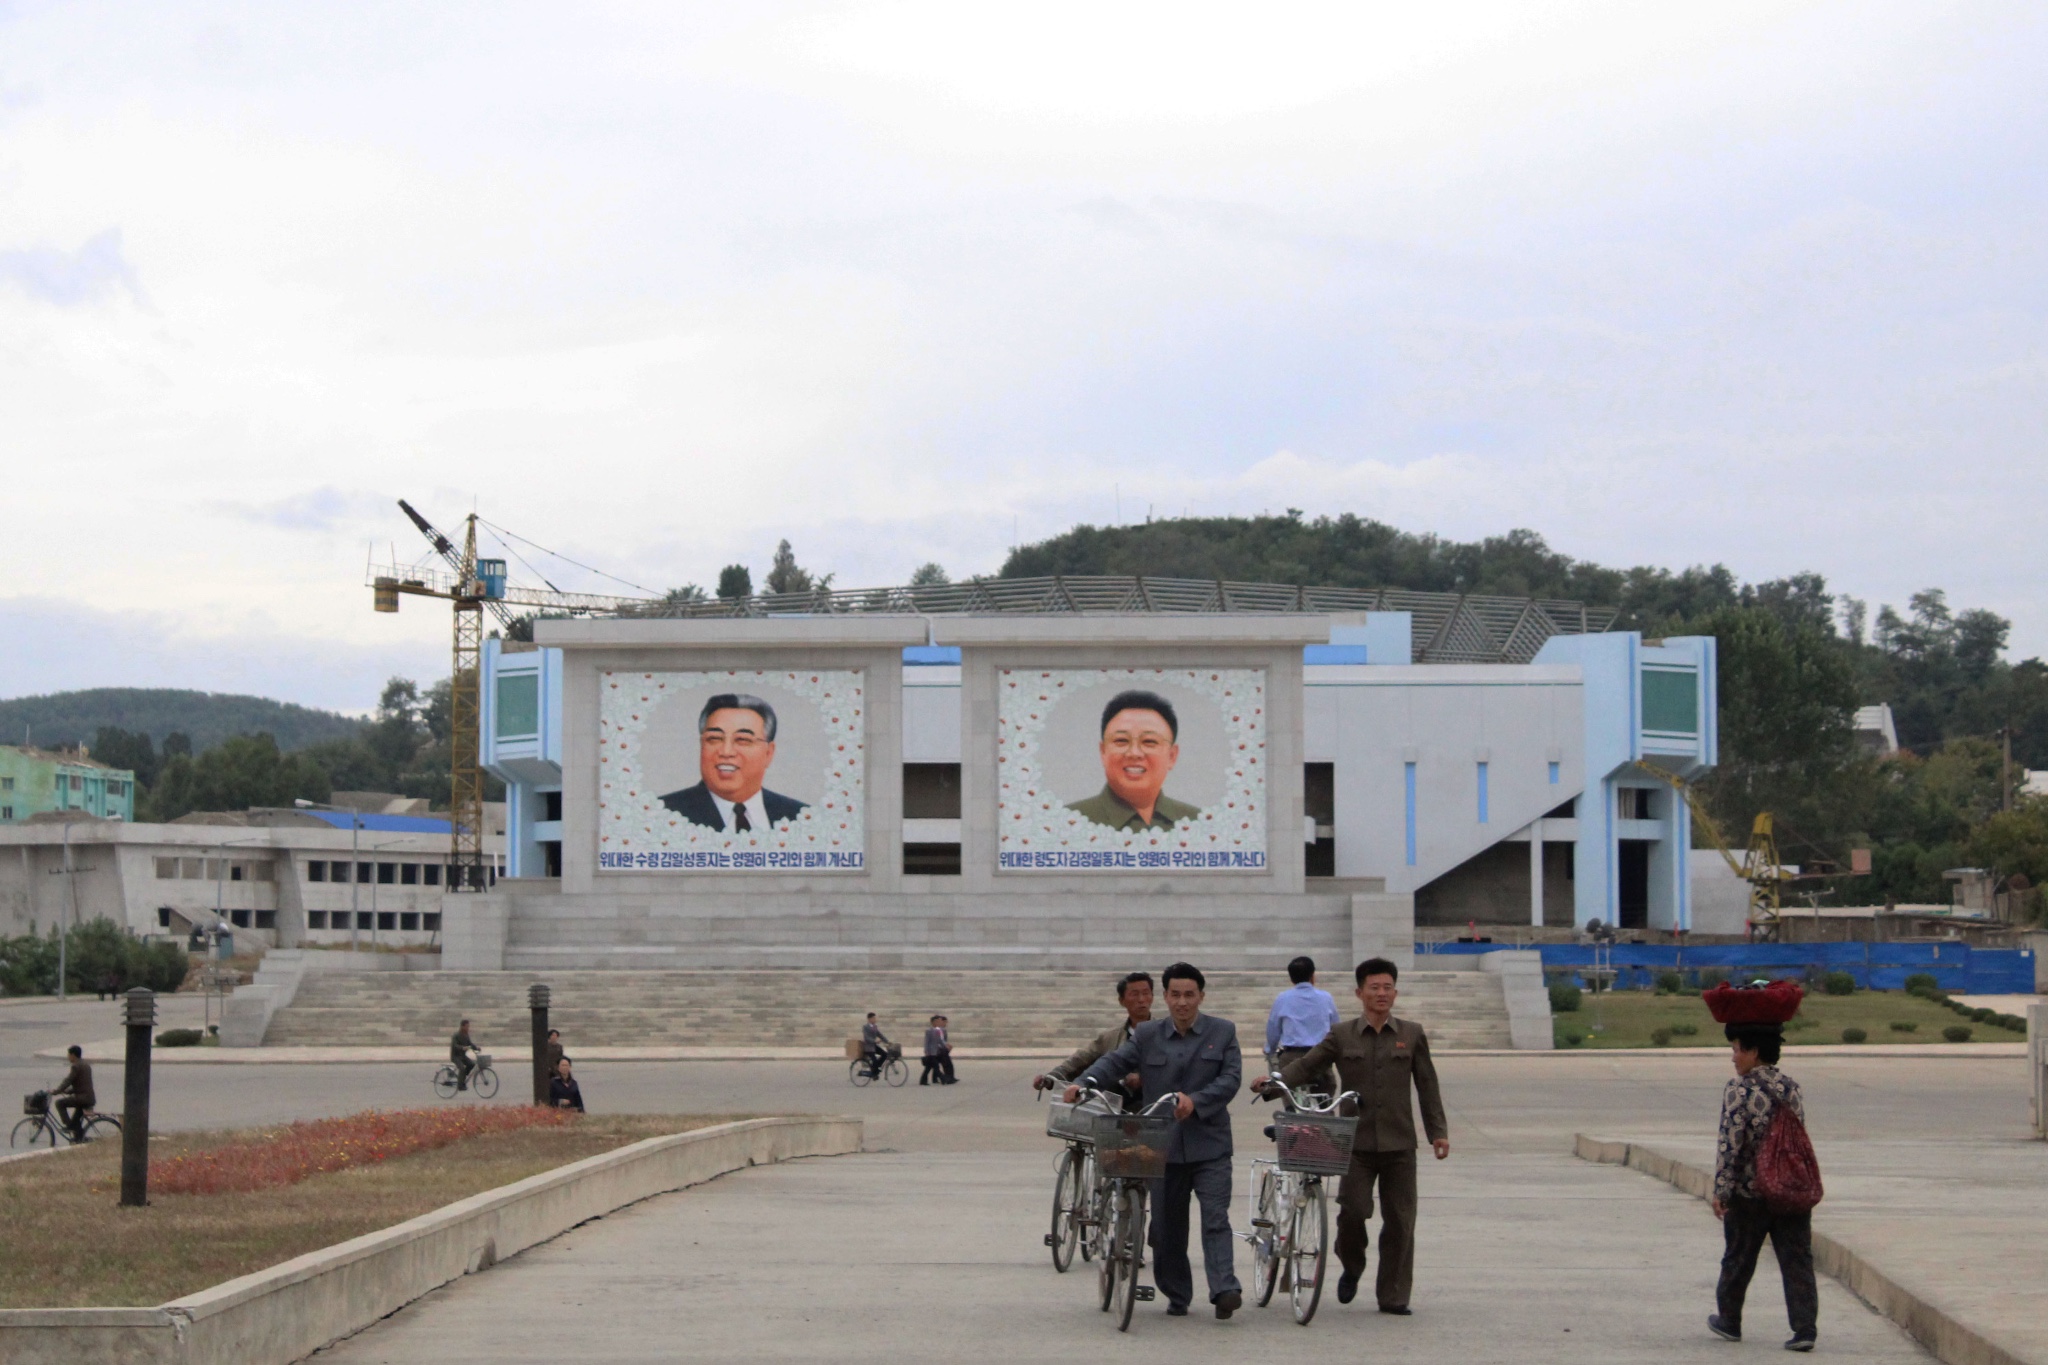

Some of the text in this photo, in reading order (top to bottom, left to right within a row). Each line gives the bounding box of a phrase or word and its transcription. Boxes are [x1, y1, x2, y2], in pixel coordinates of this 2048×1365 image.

[600, 851, 634, 867] 위대한
[636, 851, 659, 867] 수령
[732, 851, 766, 867] 영원히
[768, 851, 802, 867] 우리와
[804, 851, 827, 867] 함께
[828, 851, 863, 867] 계신다
[1000, 851, 1033, 867] 위대한
[1035, 851, 1068, 867] 령도자
[1138, 851, 1171, 867] 영원히
[1172, 851, 1206, 867] 우리와
[1207, 851, 1230, 867] 함께
[1231, 851, 1265, 867] 계신다
